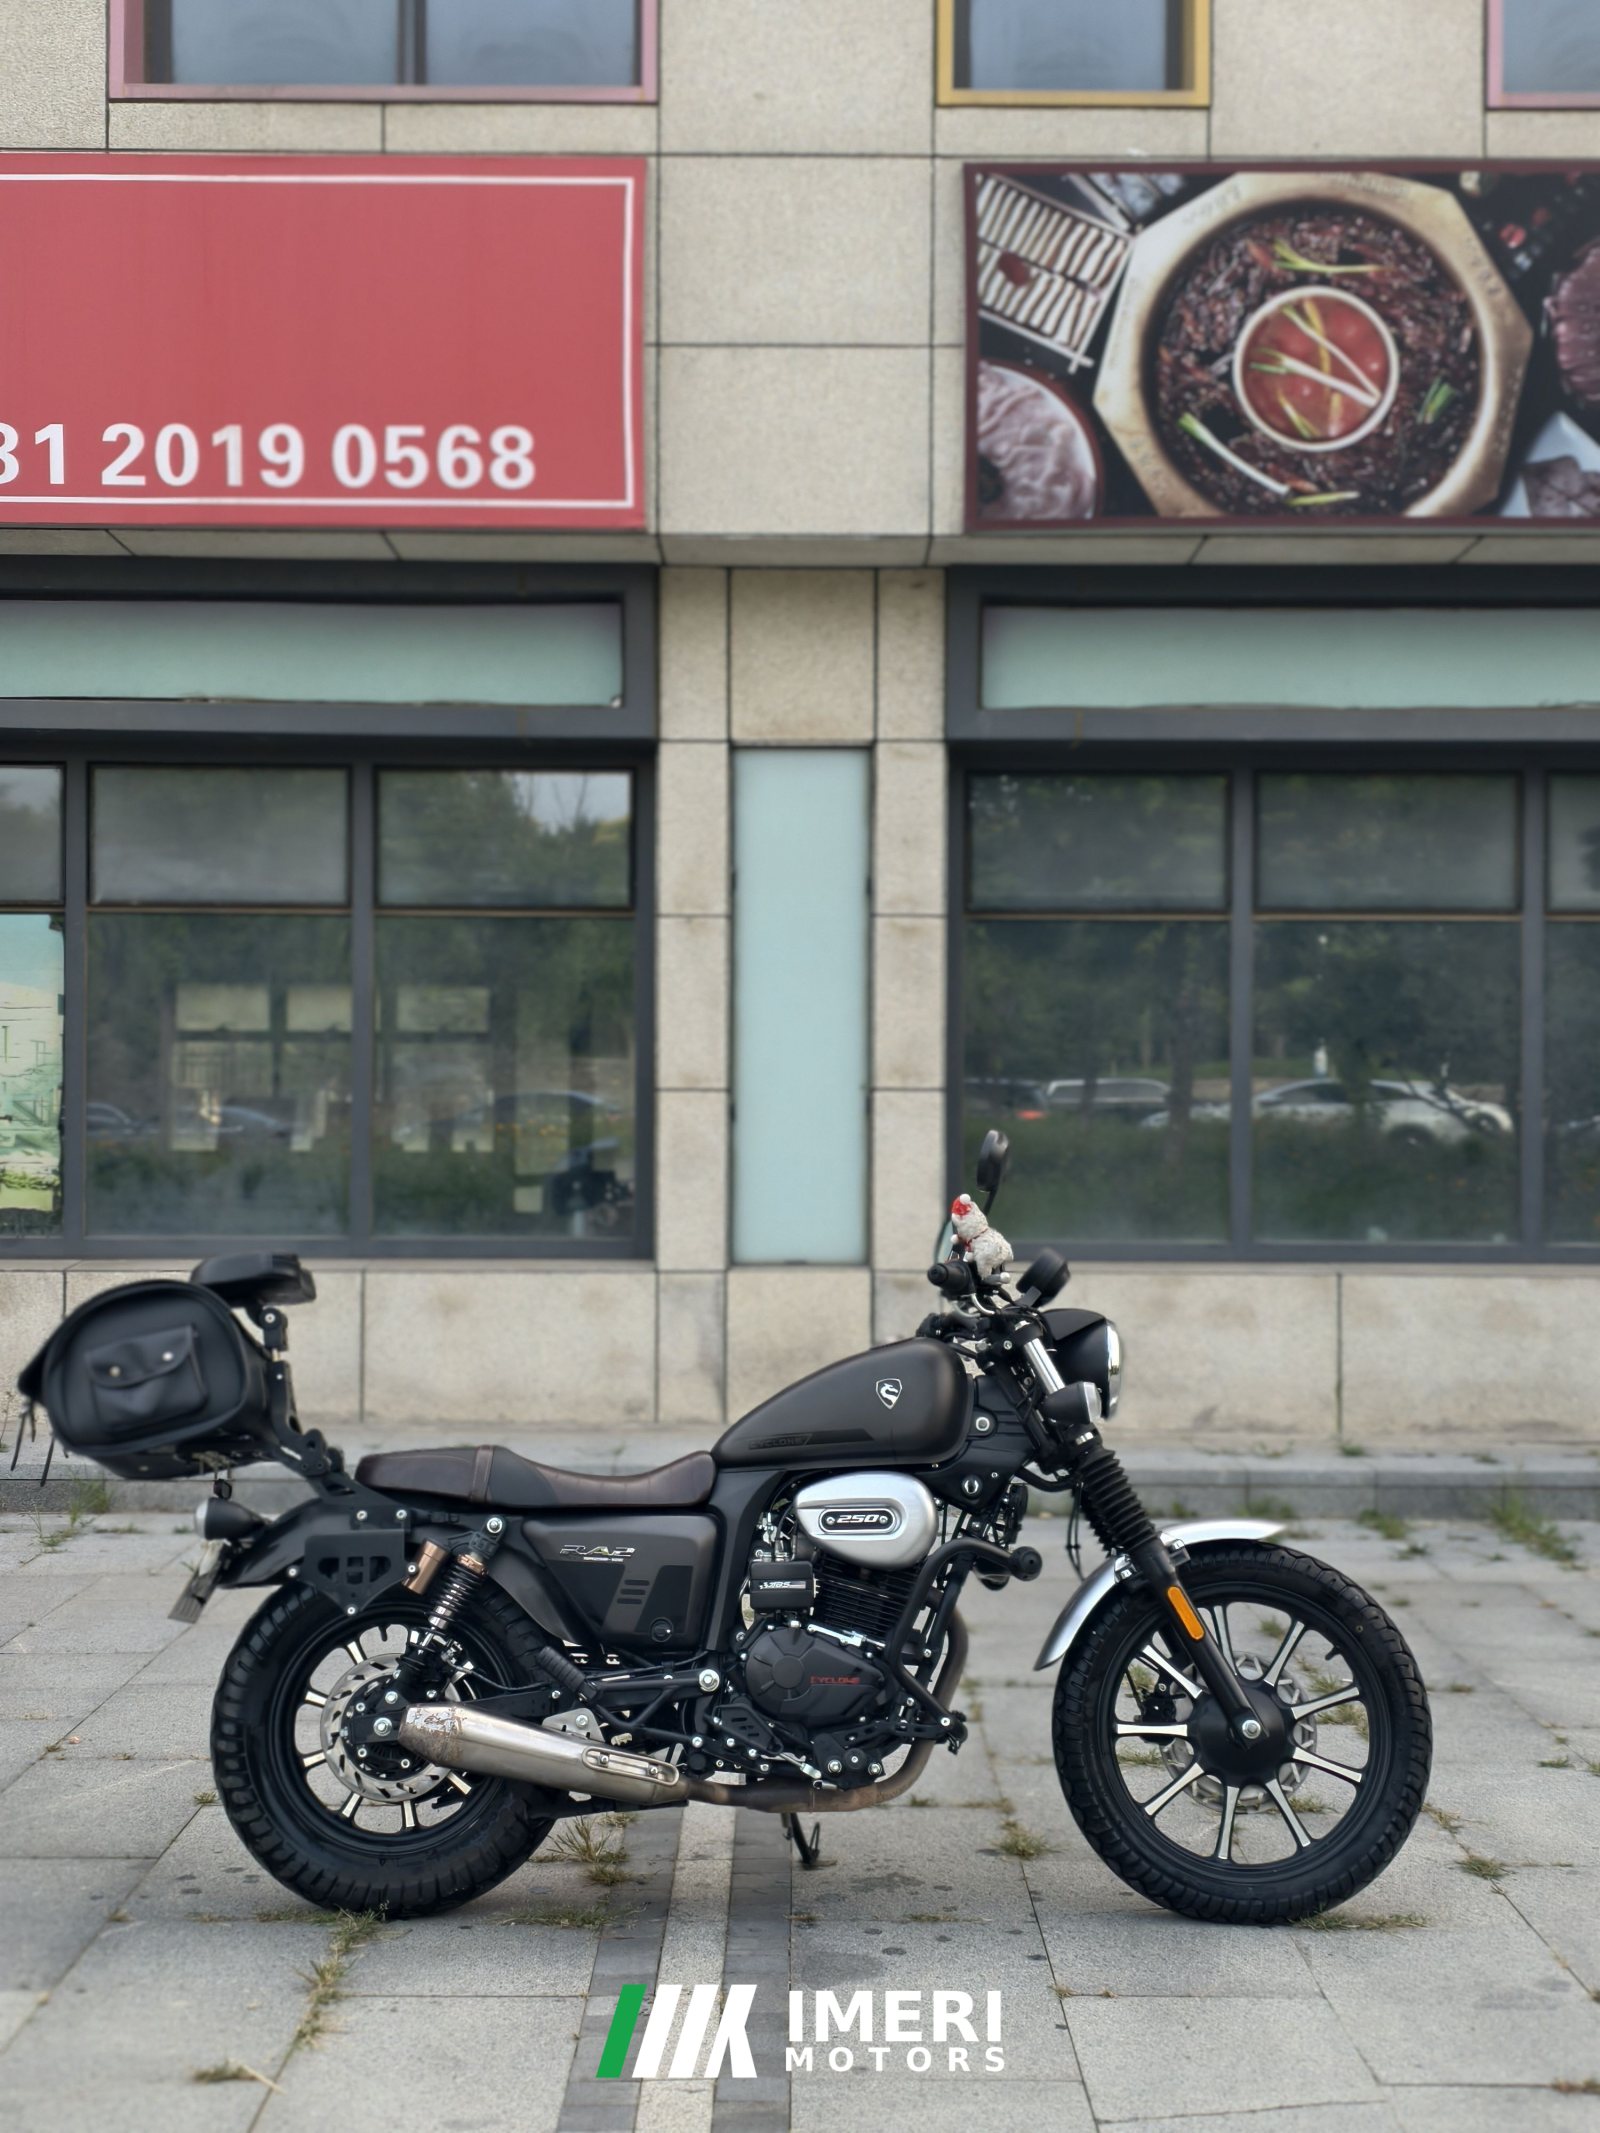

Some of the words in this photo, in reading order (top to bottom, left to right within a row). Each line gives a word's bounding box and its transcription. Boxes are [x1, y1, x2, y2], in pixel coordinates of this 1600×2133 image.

[101, 422, 304, 487] 2019
[331, 425, 535, 490] 0568
[836, 1514, 880, 1524] 250
